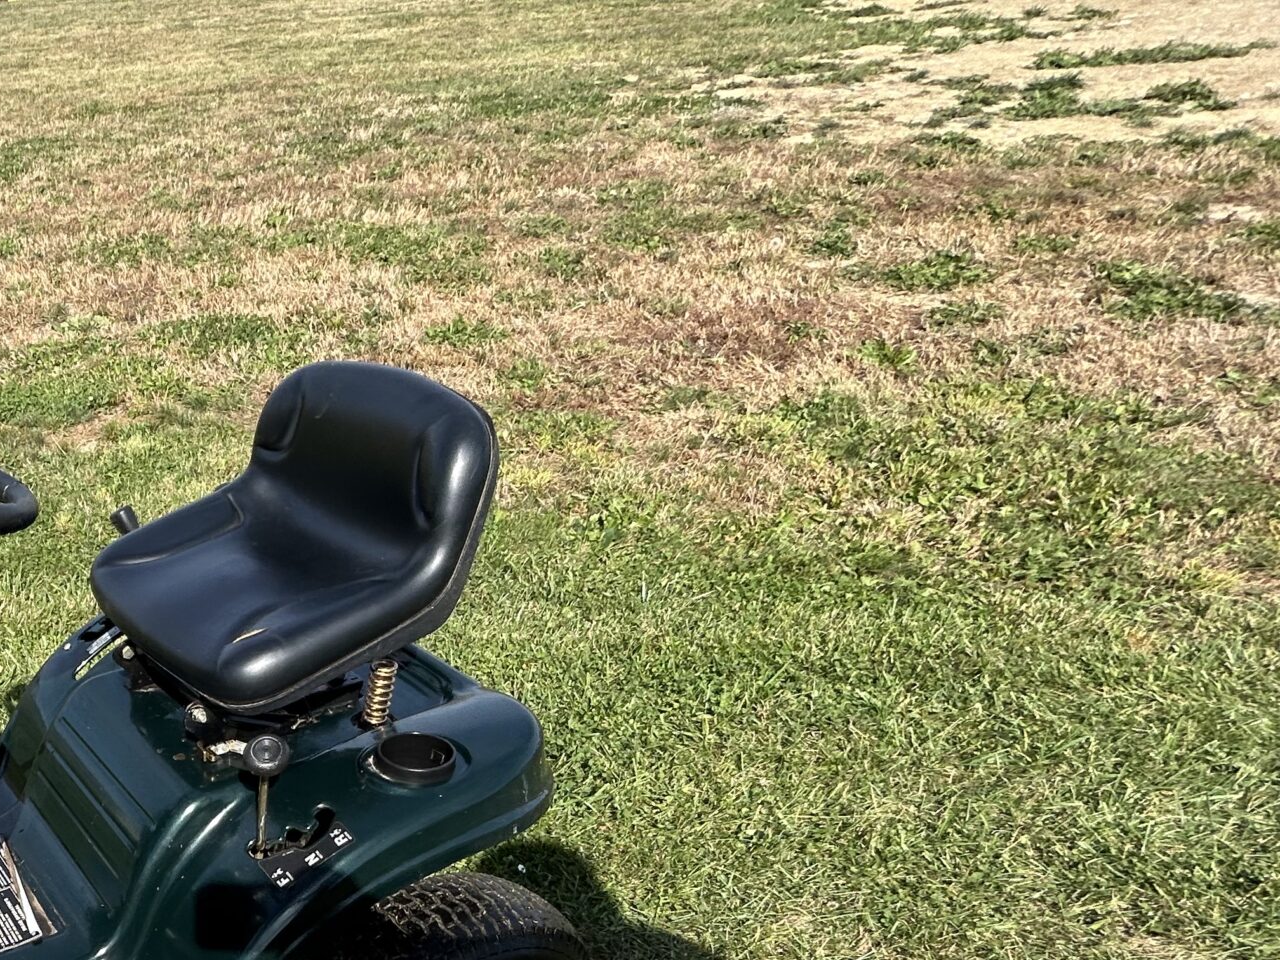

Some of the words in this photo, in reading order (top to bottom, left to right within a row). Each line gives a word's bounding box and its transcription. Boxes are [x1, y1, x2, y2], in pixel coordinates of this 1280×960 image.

[334, 833, 348, 847] R
[304, 853, 320, 866] N
[276, 877, 290, 888] F
